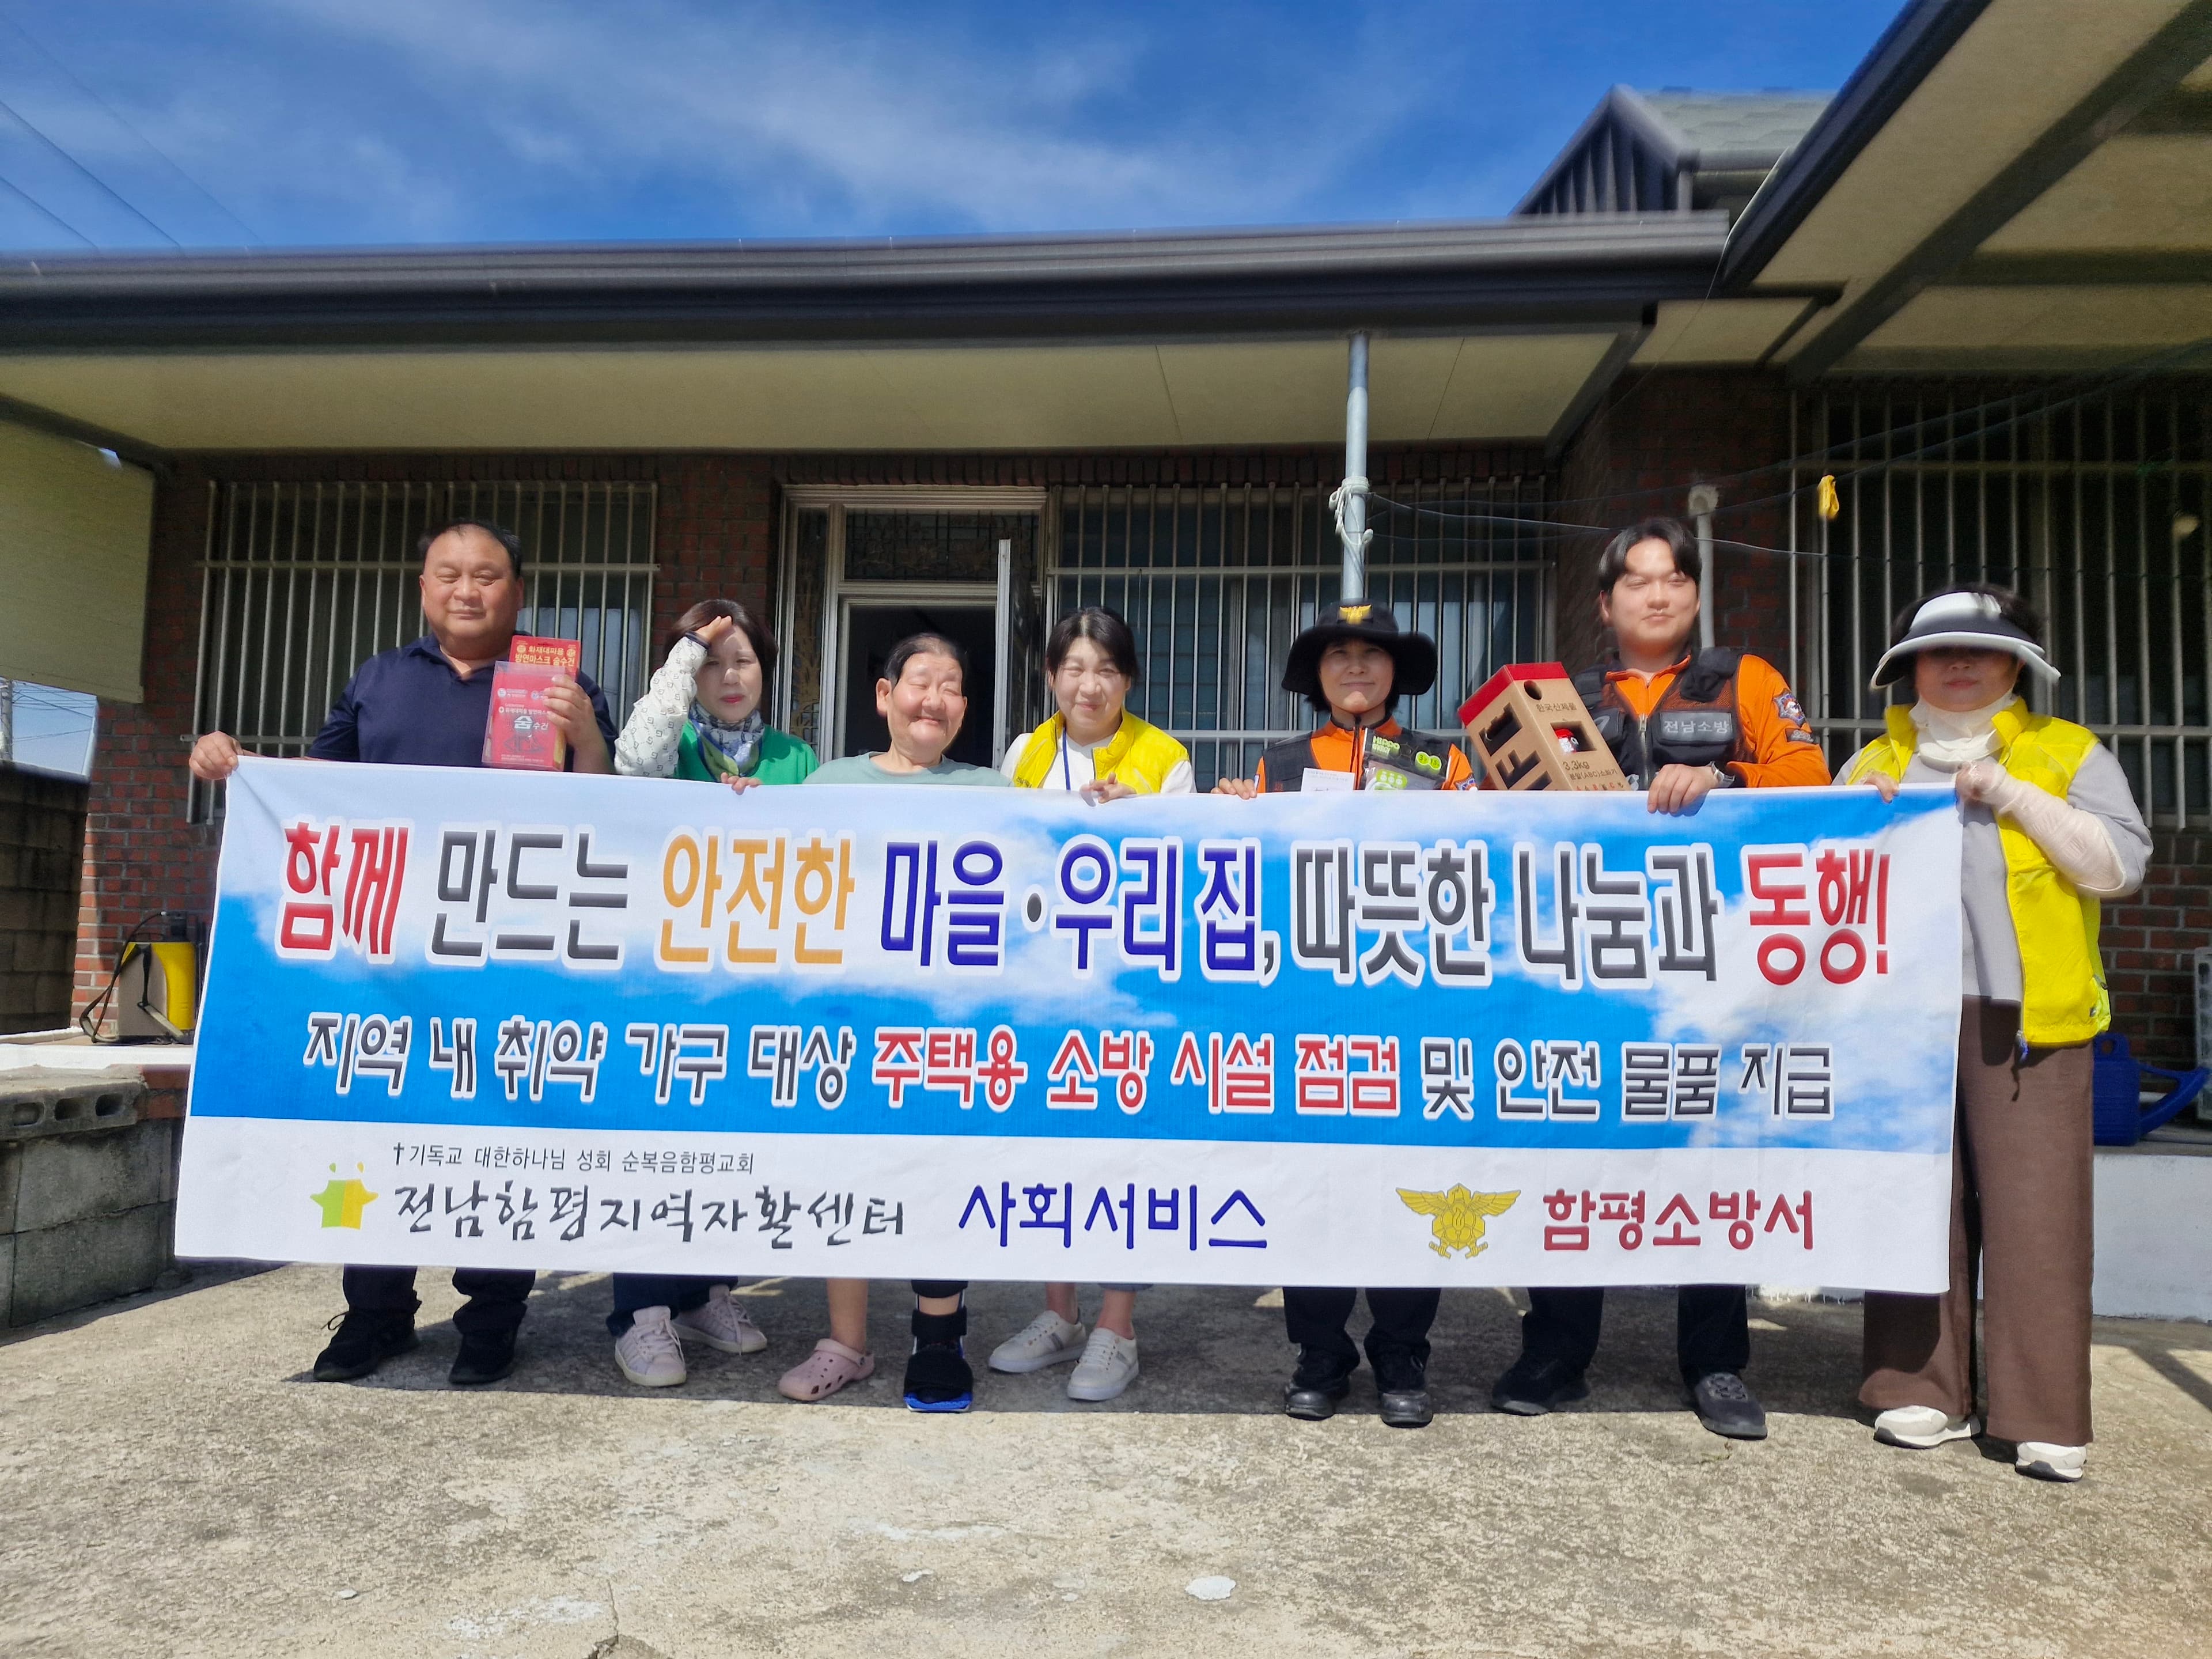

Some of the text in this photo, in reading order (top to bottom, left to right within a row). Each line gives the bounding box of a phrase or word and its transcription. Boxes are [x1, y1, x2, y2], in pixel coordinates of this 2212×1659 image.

[515, 653, 551, 664] 방연마스크
[1536, 702, 1577, 713] 한국산제품
[533, 722, 549, 730] 수건
[1664, 719, 1729, 734] 전남소방
[1562, 759, 1590, 771] 3.3kg
[279, 821, 410, 955] 함께
[430, 828, 629, 961] 만드는
[659, 832, 857, 964] 안전한
[1294, 846, 1491, 977] 따뜻한
[1517, 850, 1719, 982] 나눔과
[1746, 849, 1891, 986] 동행!
[305, 1016, 1832, 1116] 지역 내 취약 가구 대상 주택용 소방 시설 점검 및 안전 물품 지급
[473, 1145, 567, 1171] 대한하나님
[575, 1149, 612, 1173] 성회
[620, 1150, 755, 1175] 순복음함평교회
[393, 1178, 905, 1250] 전남함평지역자활센터
[957, 1180, 1269, 1252] 사회서비스
[1541, 1188, 1815, 1251] 함평소방서
